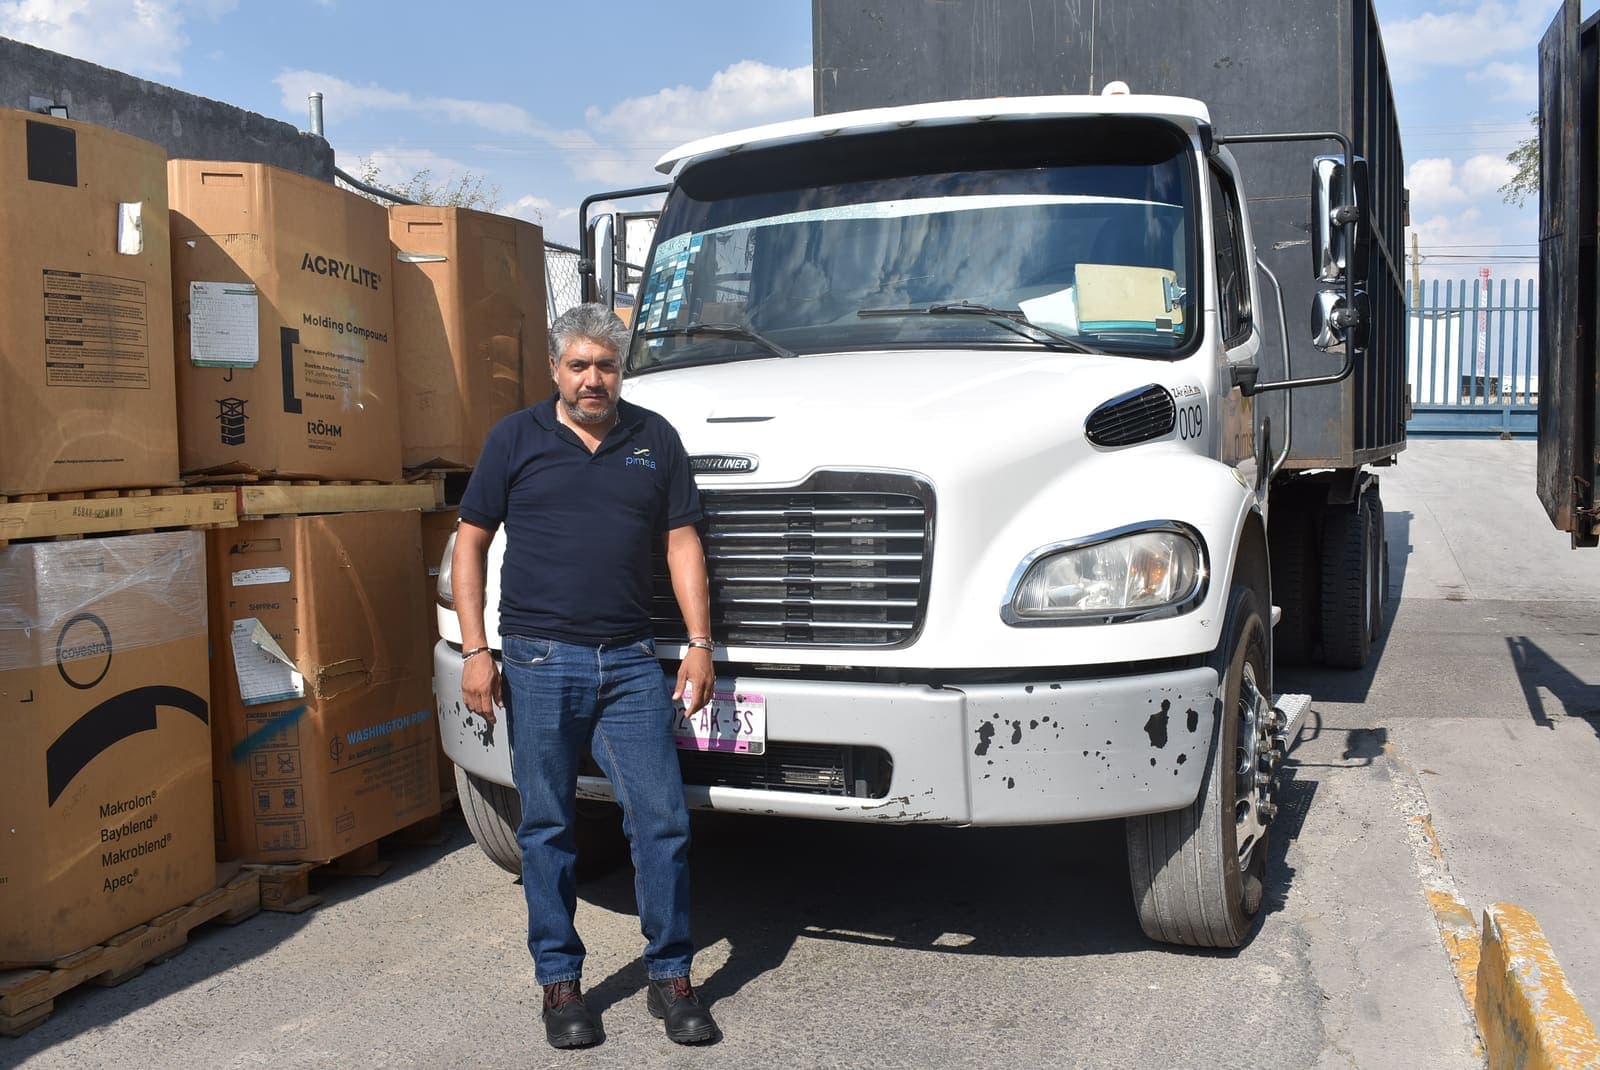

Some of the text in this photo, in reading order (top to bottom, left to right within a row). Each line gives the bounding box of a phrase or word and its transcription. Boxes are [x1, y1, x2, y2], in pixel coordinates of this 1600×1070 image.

[303, 313, 388, 344] Molding Compound
[1180, 404, 1203, 440] 009
[625, 456, 657, 470] pimsa
[248, 602, 280, 611] SHIPPING
[61, 642, 107, 660] covestro
[346, 716, 410, 745] WASHINGTON
